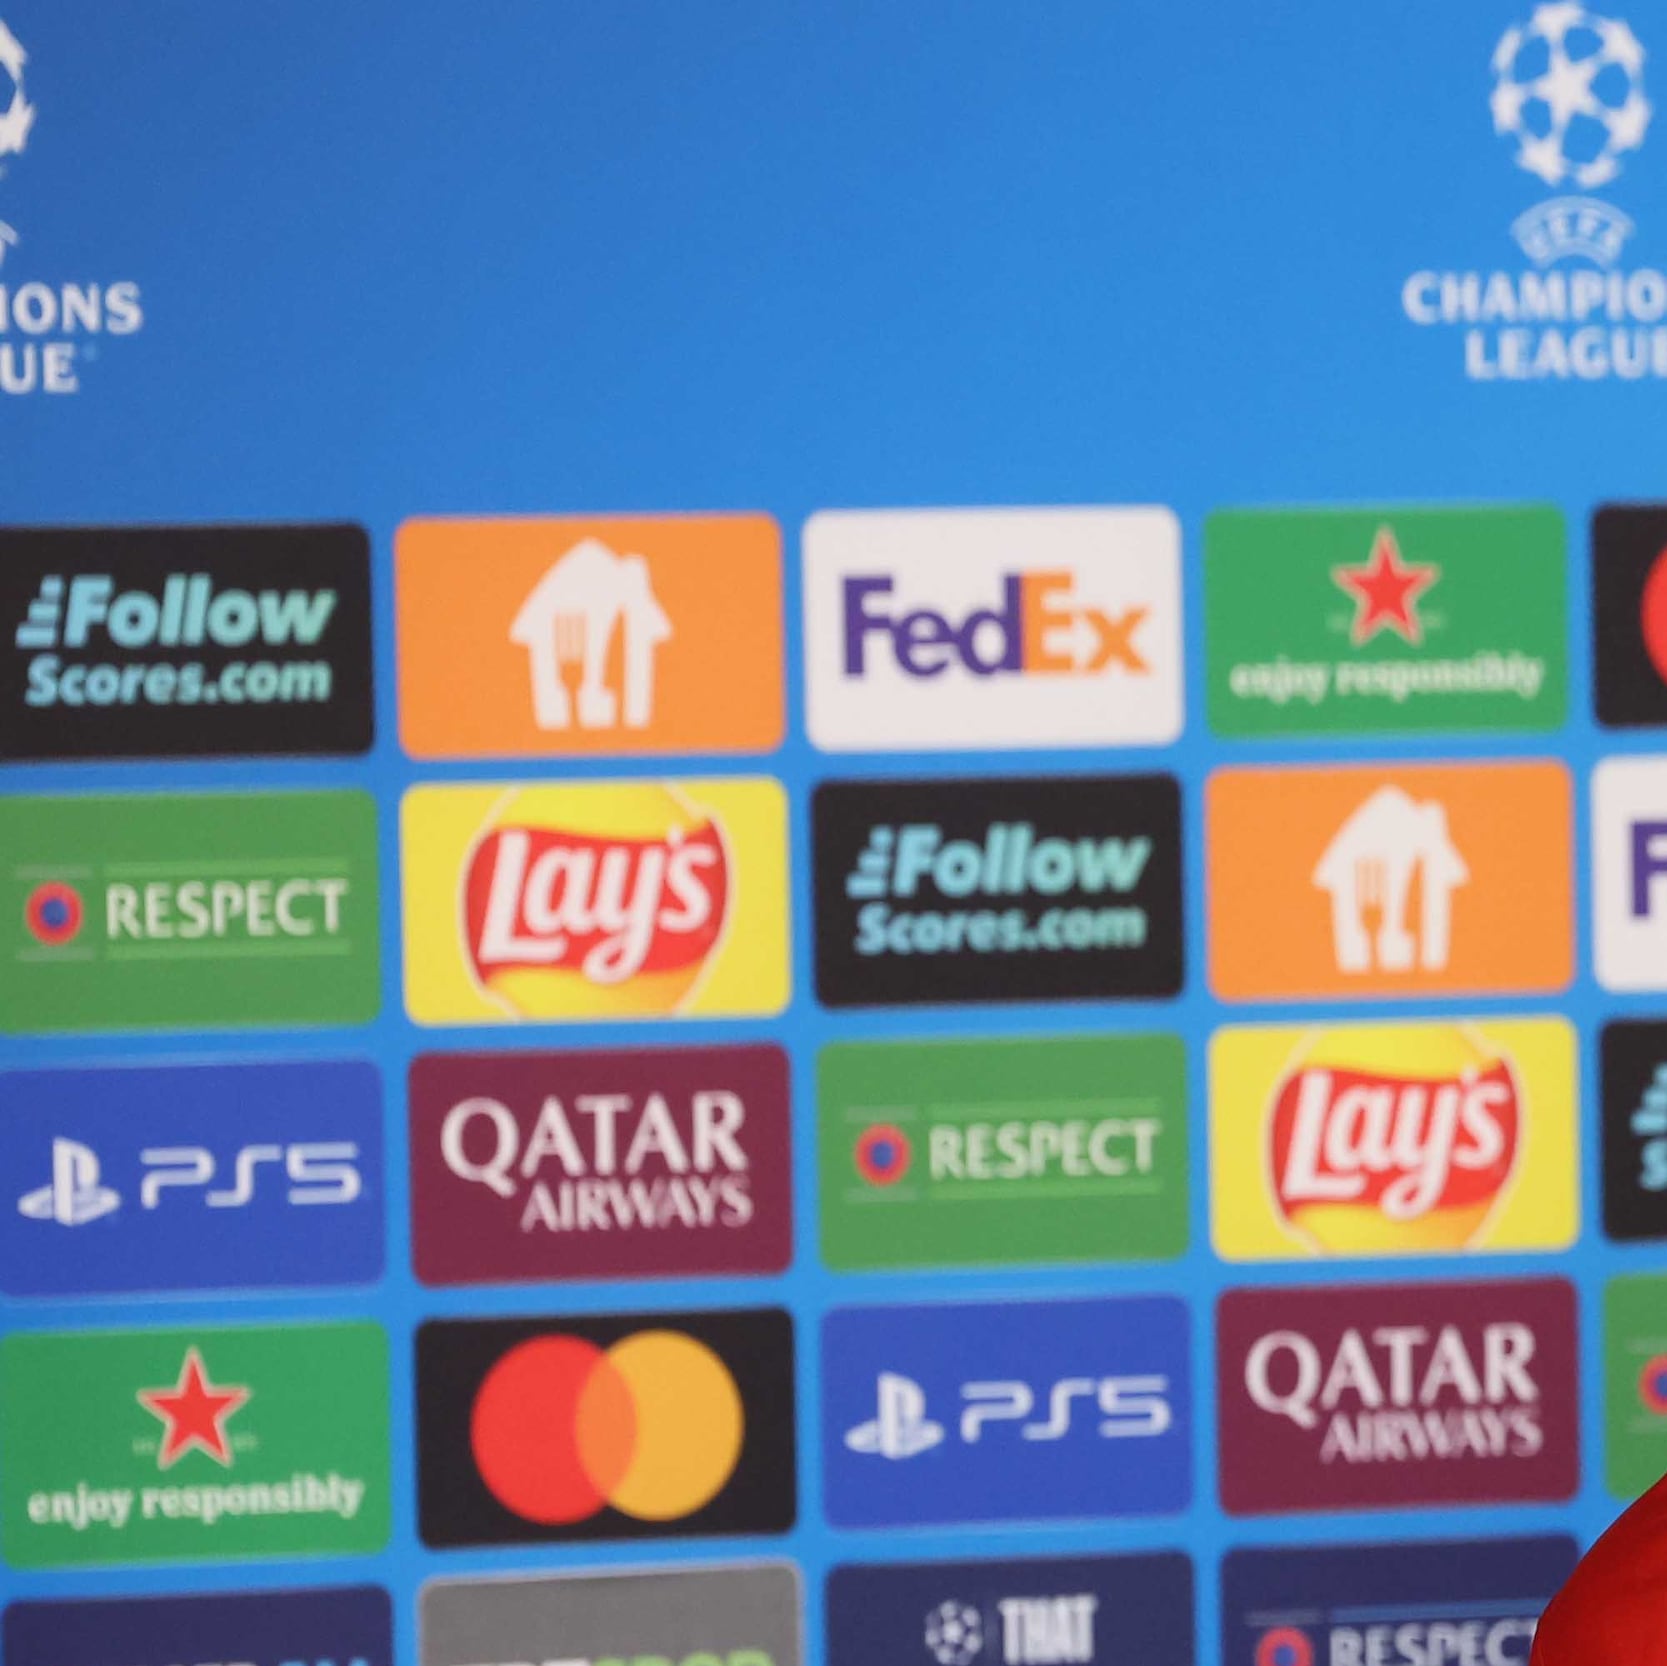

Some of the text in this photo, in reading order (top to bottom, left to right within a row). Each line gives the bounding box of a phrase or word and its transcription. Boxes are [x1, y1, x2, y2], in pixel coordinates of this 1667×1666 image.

[840, 567, 1152, 681] FedEx
[25, 654, 332, 706] Scores.com
[1229, 648, 1546, 706] enjoy responsibly
[104, 876, 350, 941] RESPECT
[476, 826, 718, 984] Lay's
[854, 900, 1147, 954] Scores.com
[440, 1090, 749, 1198] QATAR
[927, 1116, 1165, 1182] RESPECT
[1280, 1063, 1511, 1220] Lay's
[138, 1141, 362, 1210] PS5
[520, 1173, 755, 1232] AIRWAYS
[959, 1373, 1172, 1444] PS5
[1245, 1321, 1539, 1431] QATAR
[1319, 1403, 1543, 1463] AIRWAYS
[27, 1470, 365, 1531] enjoy responsibly
